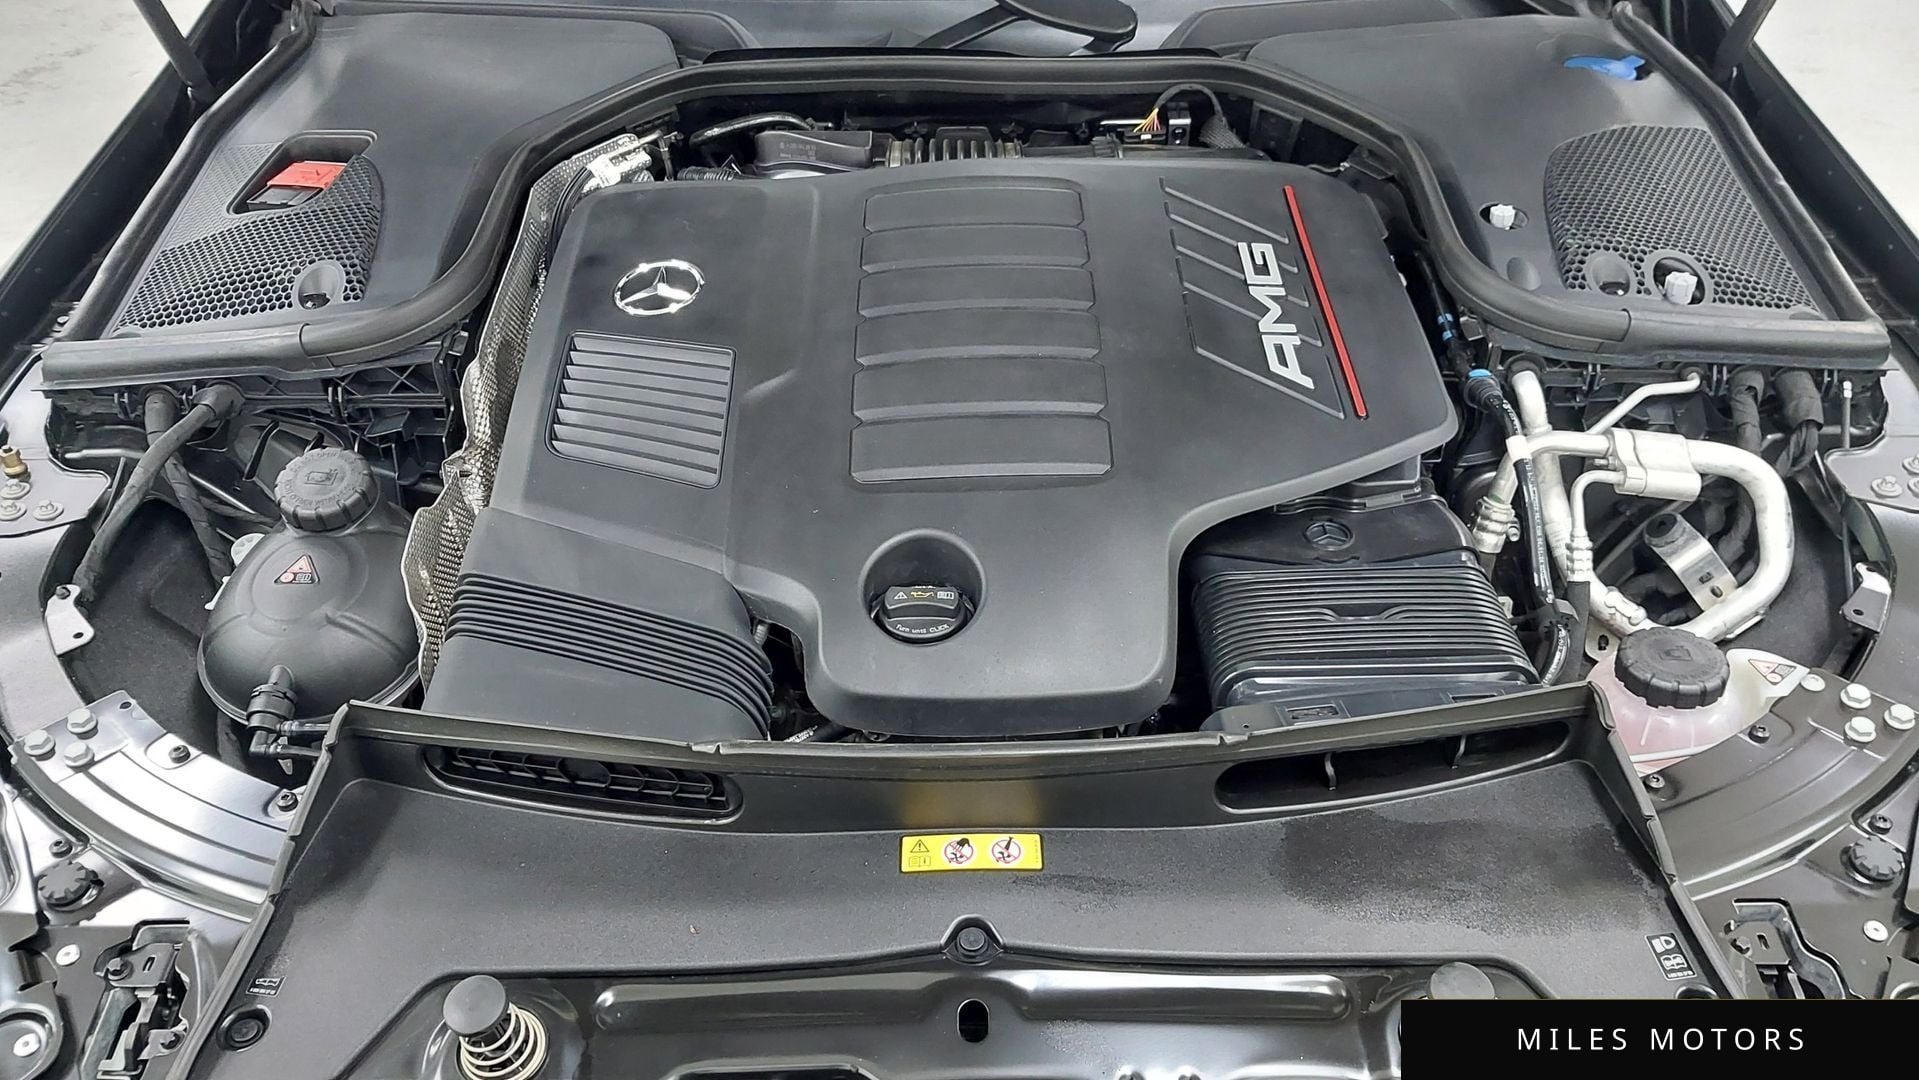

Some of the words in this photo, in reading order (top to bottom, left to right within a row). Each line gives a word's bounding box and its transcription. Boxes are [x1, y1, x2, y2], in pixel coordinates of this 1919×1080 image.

[1238, 242, 1315, 390] AMG
[896, 624, 910, 633] Turn
[929, 623, 950, 633] CLICK
